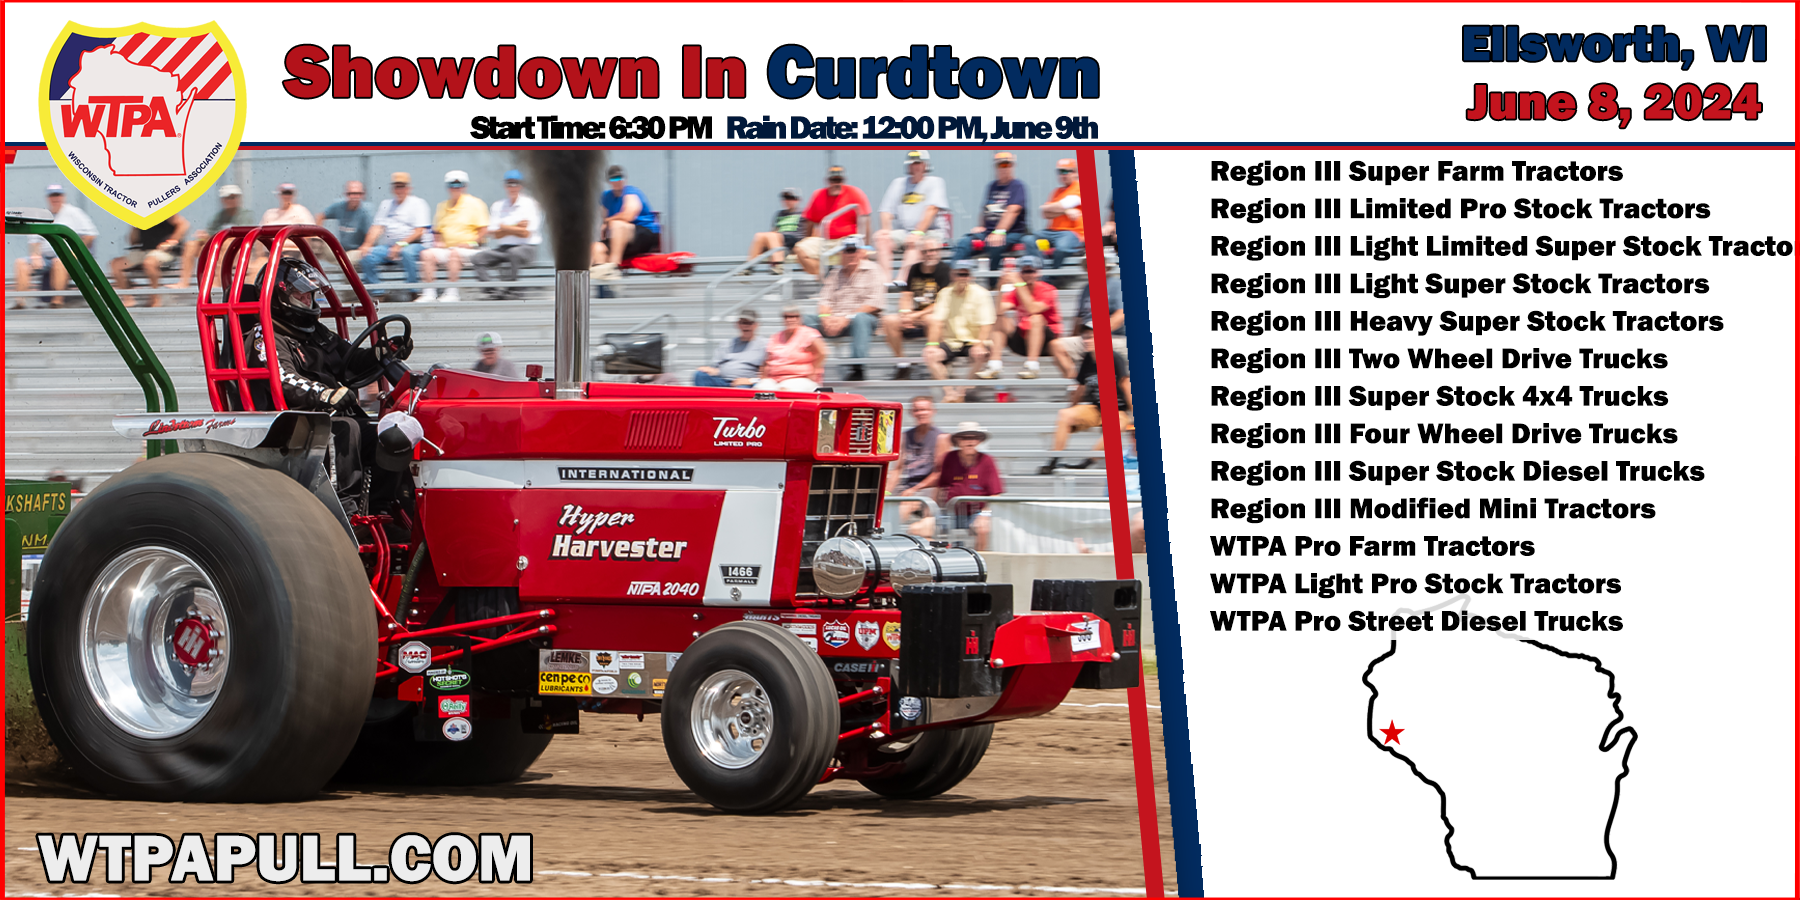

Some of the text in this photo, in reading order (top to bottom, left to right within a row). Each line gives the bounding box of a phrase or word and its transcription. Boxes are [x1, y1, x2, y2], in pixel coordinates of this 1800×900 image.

[713, 416, 766, 439] Turbo
[562, 469, 690, 480] INTERNATIONAL
[558, 504, 635, 535] Hyper
[549, 534, 688, 562] Harvester
[728, 566, 753, 577] 1466
[627, 581, 700, 597] NTPA 2040
[550, 651, 582, 664] LEMKE
[834, 663, 867, 673] CASE
[541, 685, 583, 693] LUBRICANTS
